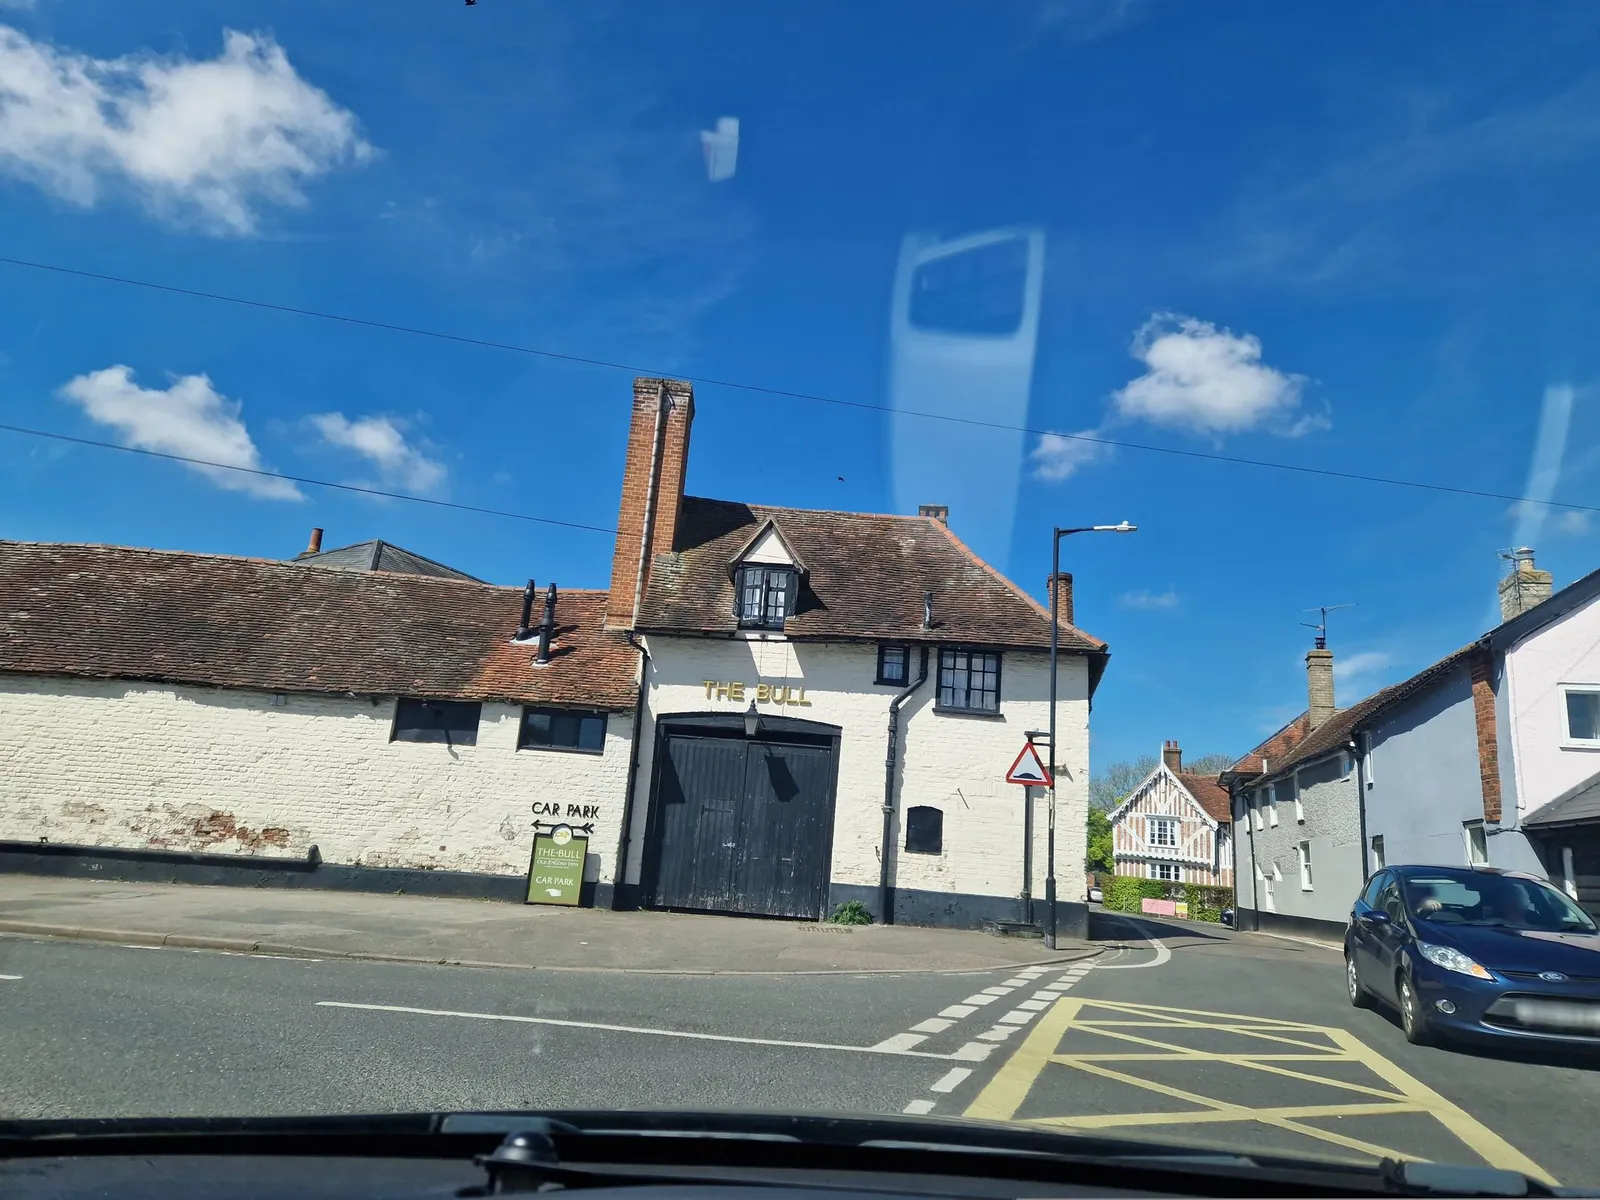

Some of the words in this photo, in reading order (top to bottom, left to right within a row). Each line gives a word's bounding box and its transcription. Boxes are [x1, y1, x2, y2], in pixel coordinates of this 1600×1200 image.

[702, 680, 744, 700] THE
[757, 684, 811, 704] BULL
[531, 802, 560, 816] CAR
[567, 804, 600, 819] PARK
[538, 848, 555, 857] THE
[558, 849, 581, 859] BULL
[535, 876, 553, 884] CAR
[554, 877, 574, 886] PARK
